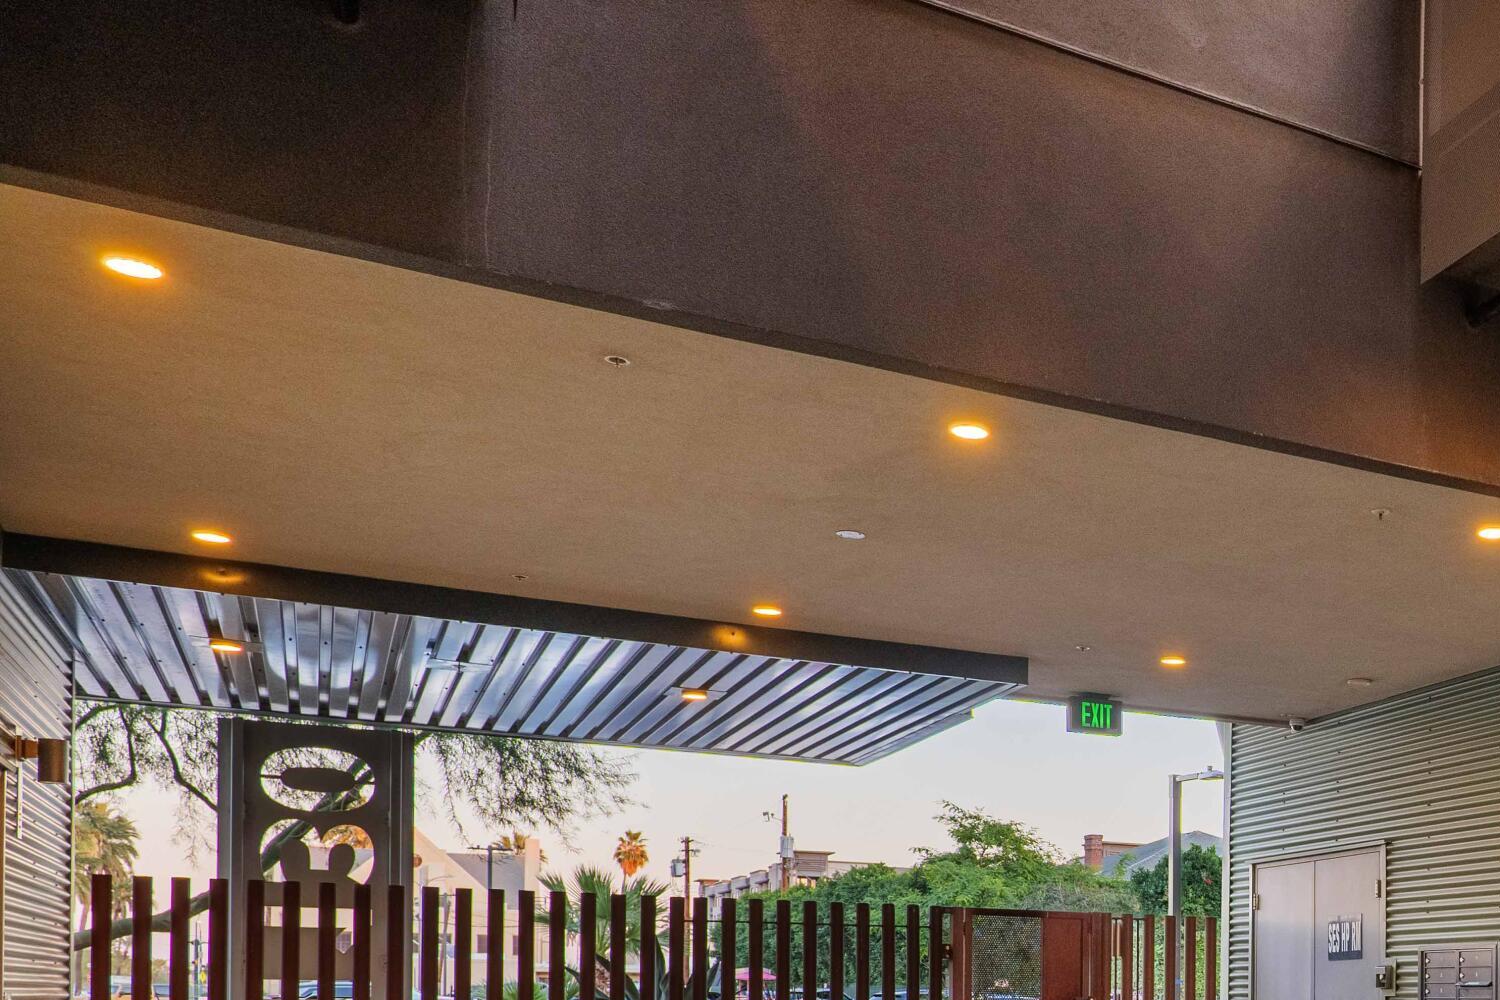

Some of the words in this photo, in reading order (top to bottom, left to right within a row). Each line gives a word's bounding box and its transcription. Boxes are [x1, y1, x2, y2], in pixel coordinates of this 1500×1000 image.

[1082, 701, 1113, 729] EXIT
[1328, 923, 1340, 953] SES
[1341, 922, 1350, 953] HP
